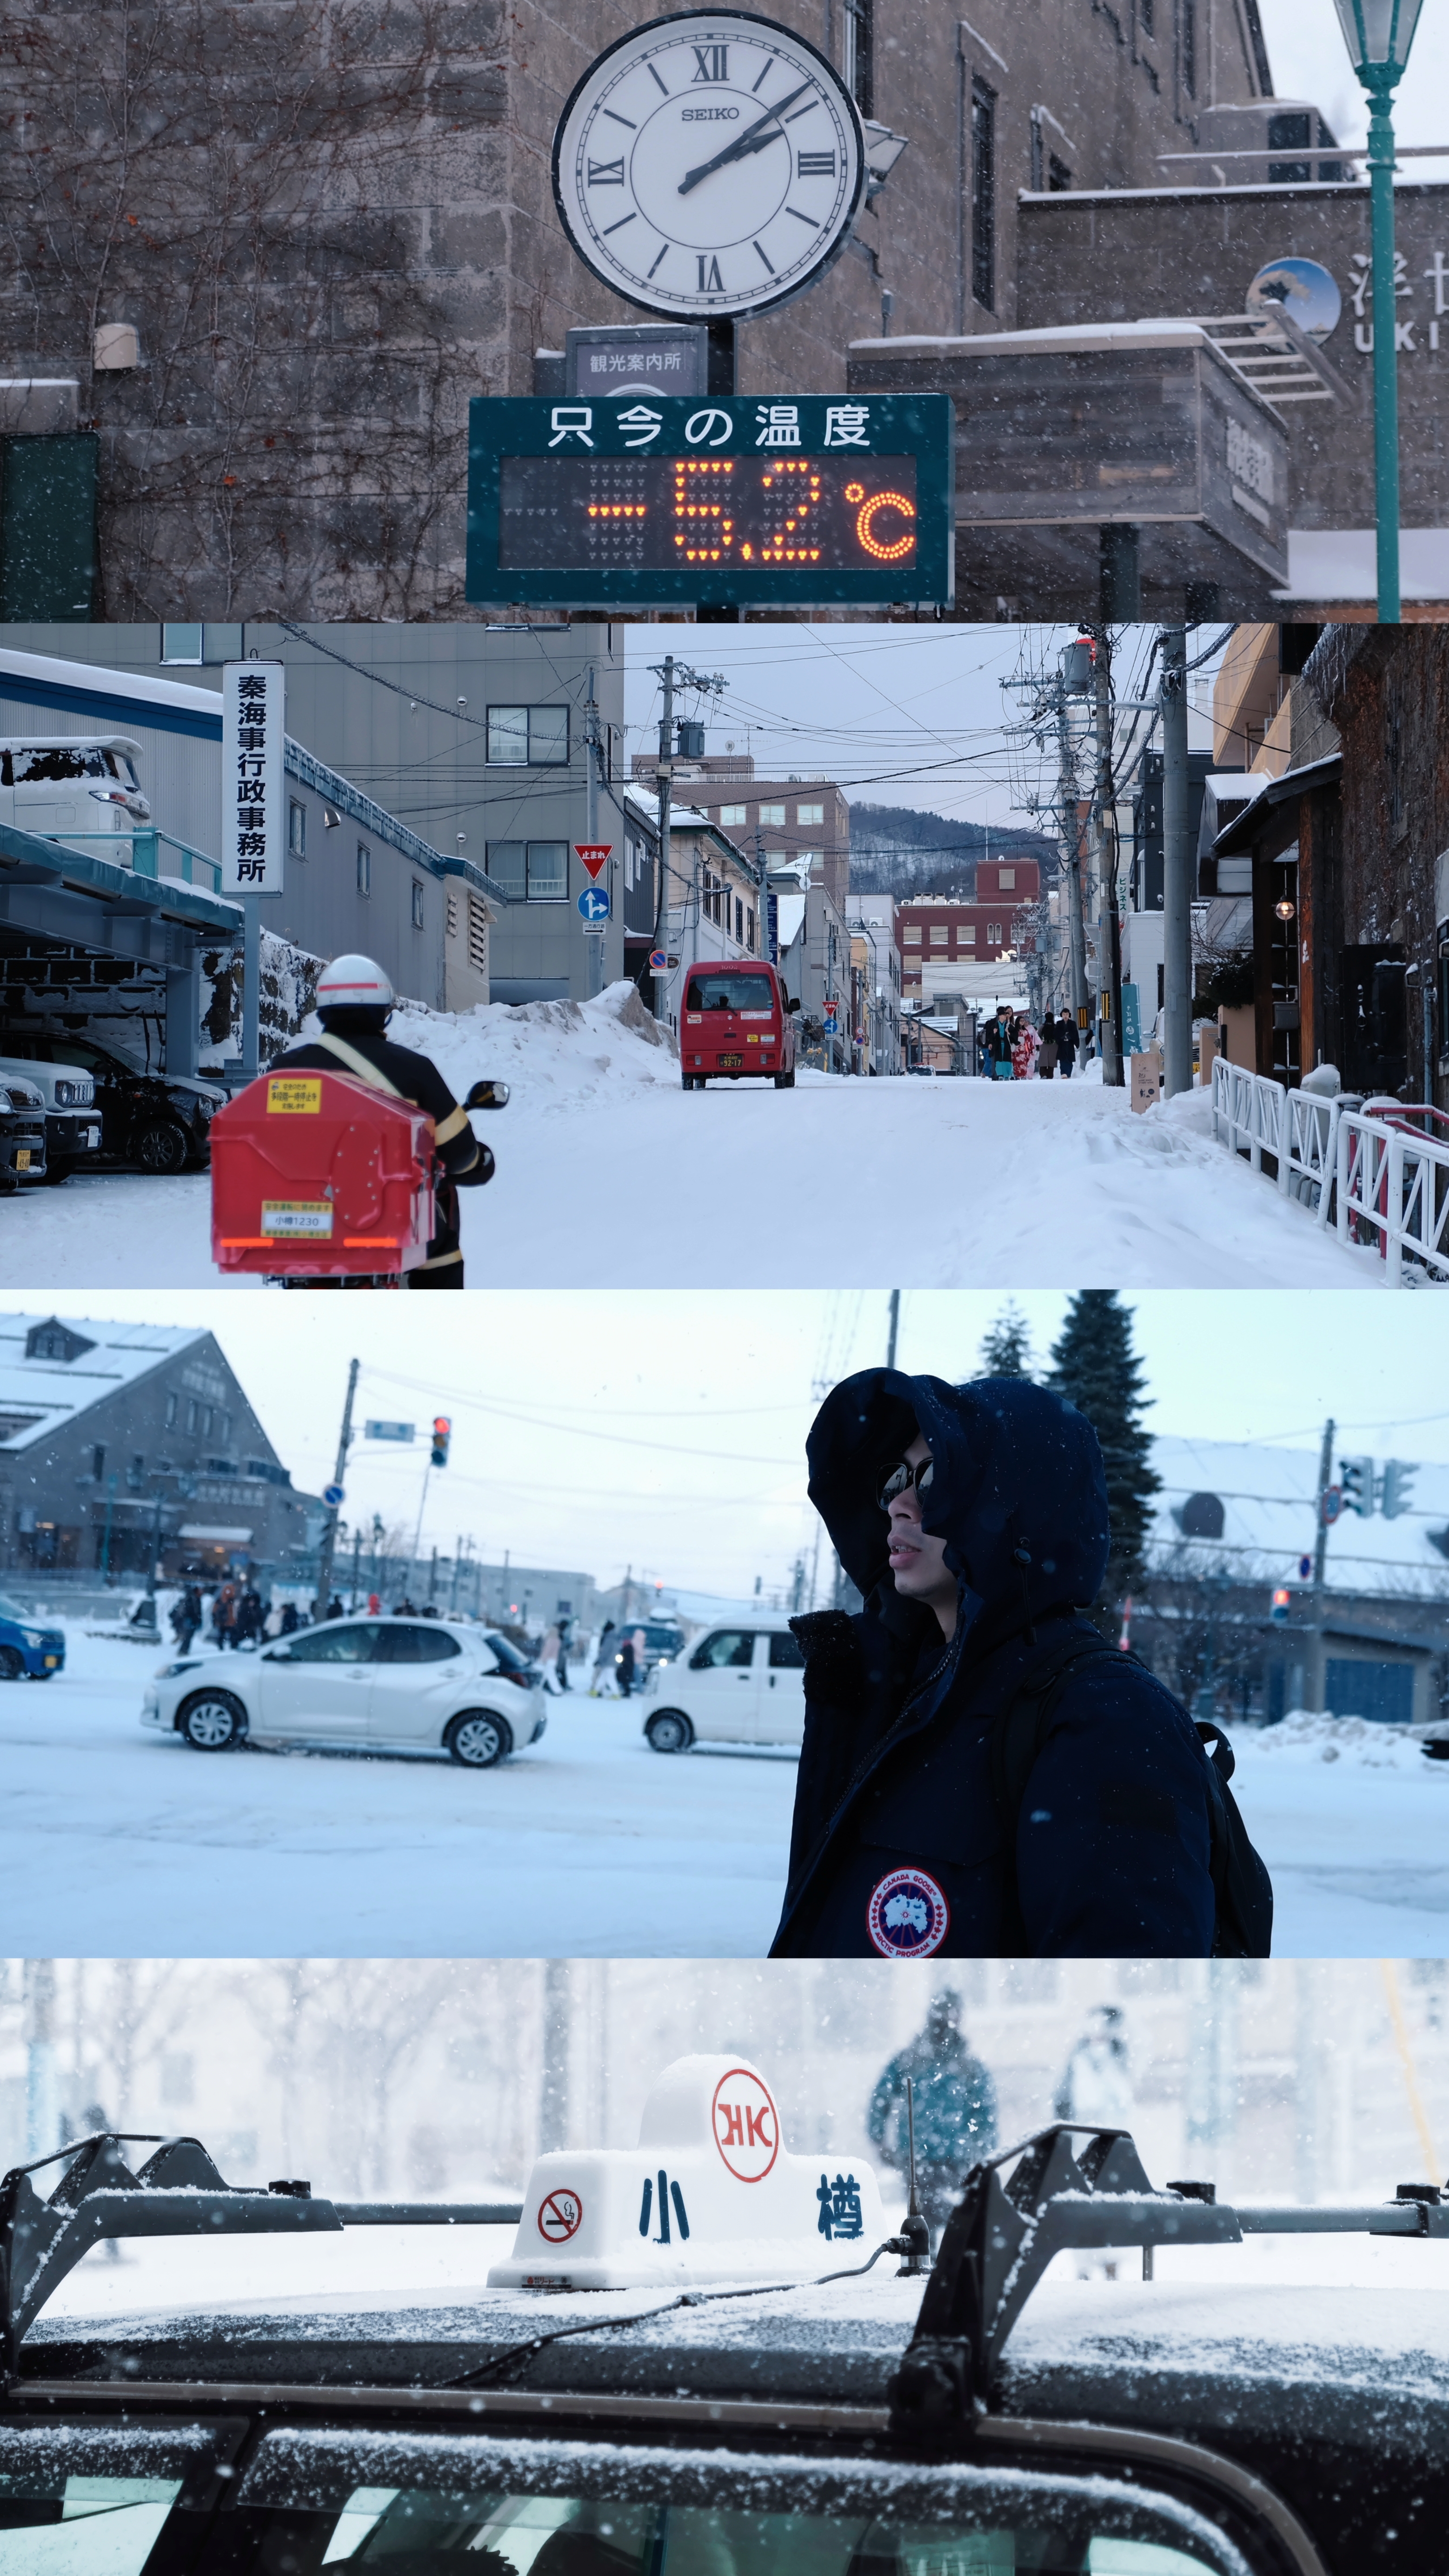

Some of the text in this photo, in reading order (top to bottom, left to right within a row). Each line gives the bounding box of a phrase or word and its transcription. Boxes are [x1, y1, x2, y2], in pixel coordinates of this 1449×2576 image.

[691, 45, 730, 82] XII
[681, 107, 739, 121] SEIKO
[590, 352, 681, 372] 観光案内所
[548, 405, 871, 447] 只今の温度
[237, 675, 267, 883] 秦海事行政事務所
[582, 851, 605, 859] 止まれ
[276, 1216, 319, 1226] 小樽1230
[883, 1874, 910, 1891] CANADA
[875, 1932, 930, 1957] ARCTIC PROGRAM
[718, 2104, 772, 2147] HK
